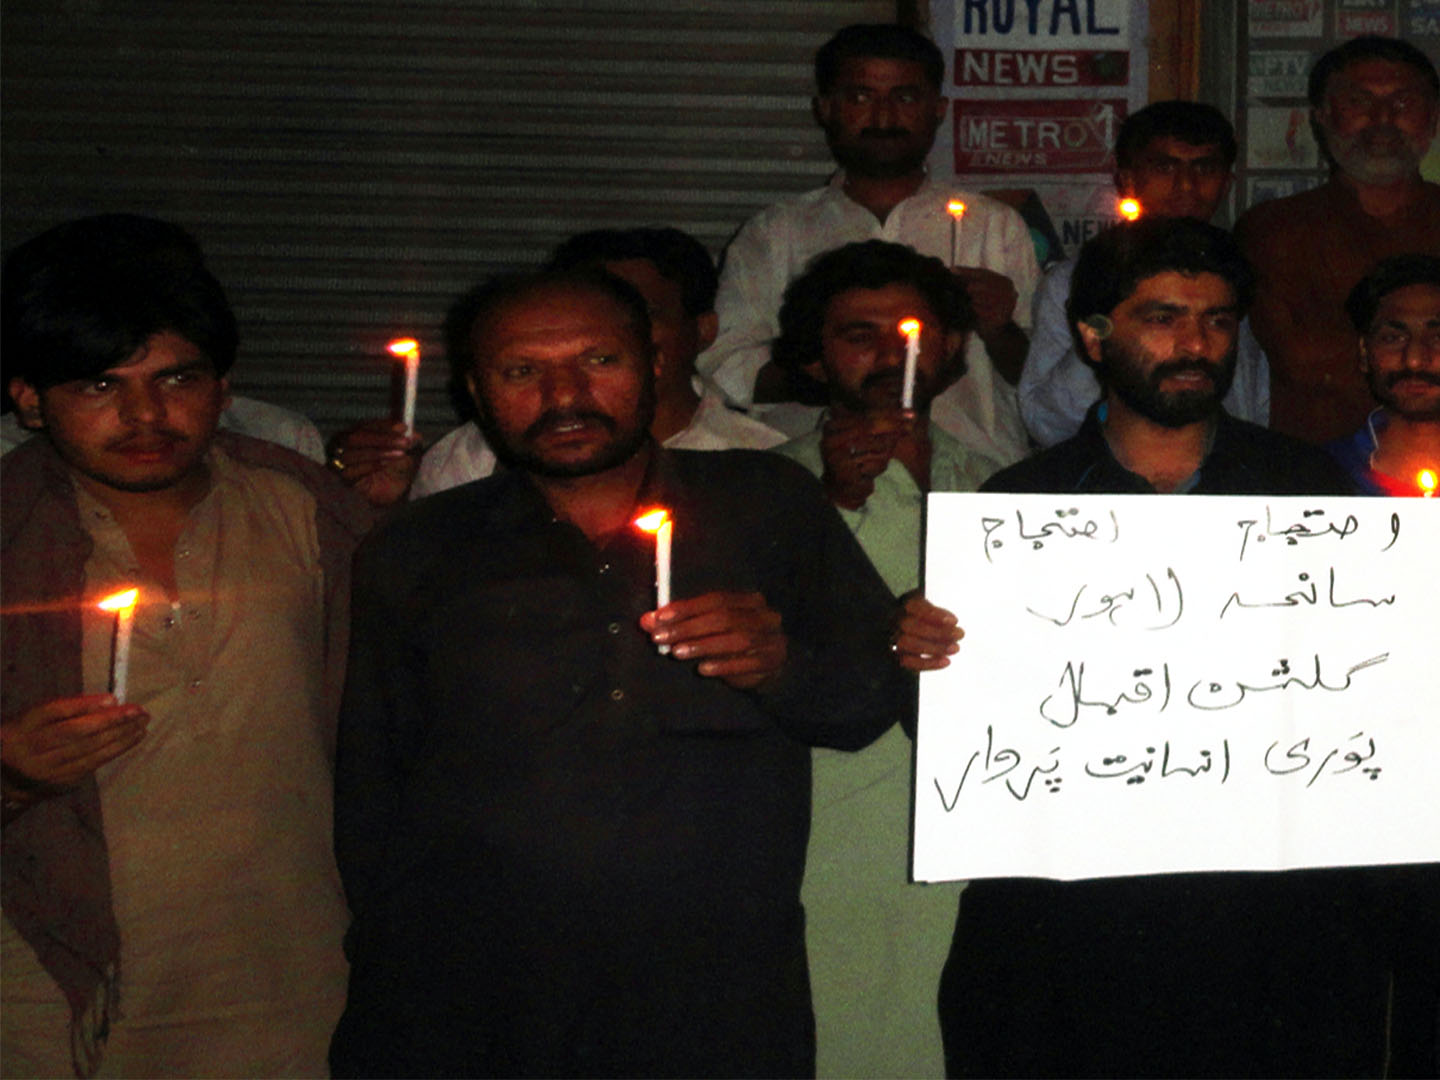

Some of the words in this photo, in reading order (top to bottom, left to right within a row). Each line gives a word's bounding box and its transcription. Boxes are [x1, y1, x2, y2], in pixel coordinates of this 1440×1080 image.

[1345, 16, 1389, 33] NEWS
[962, 51, 1079, 85] NEWS
[966, 119, 1089, 150] METRO
[984, 151, 1050, 167] NEWS
[1026, 567, 1184, 630] لاہور
[1040, 661, 1171, 728] اقبال
[1187, 652, 1390, 710] گلشن
